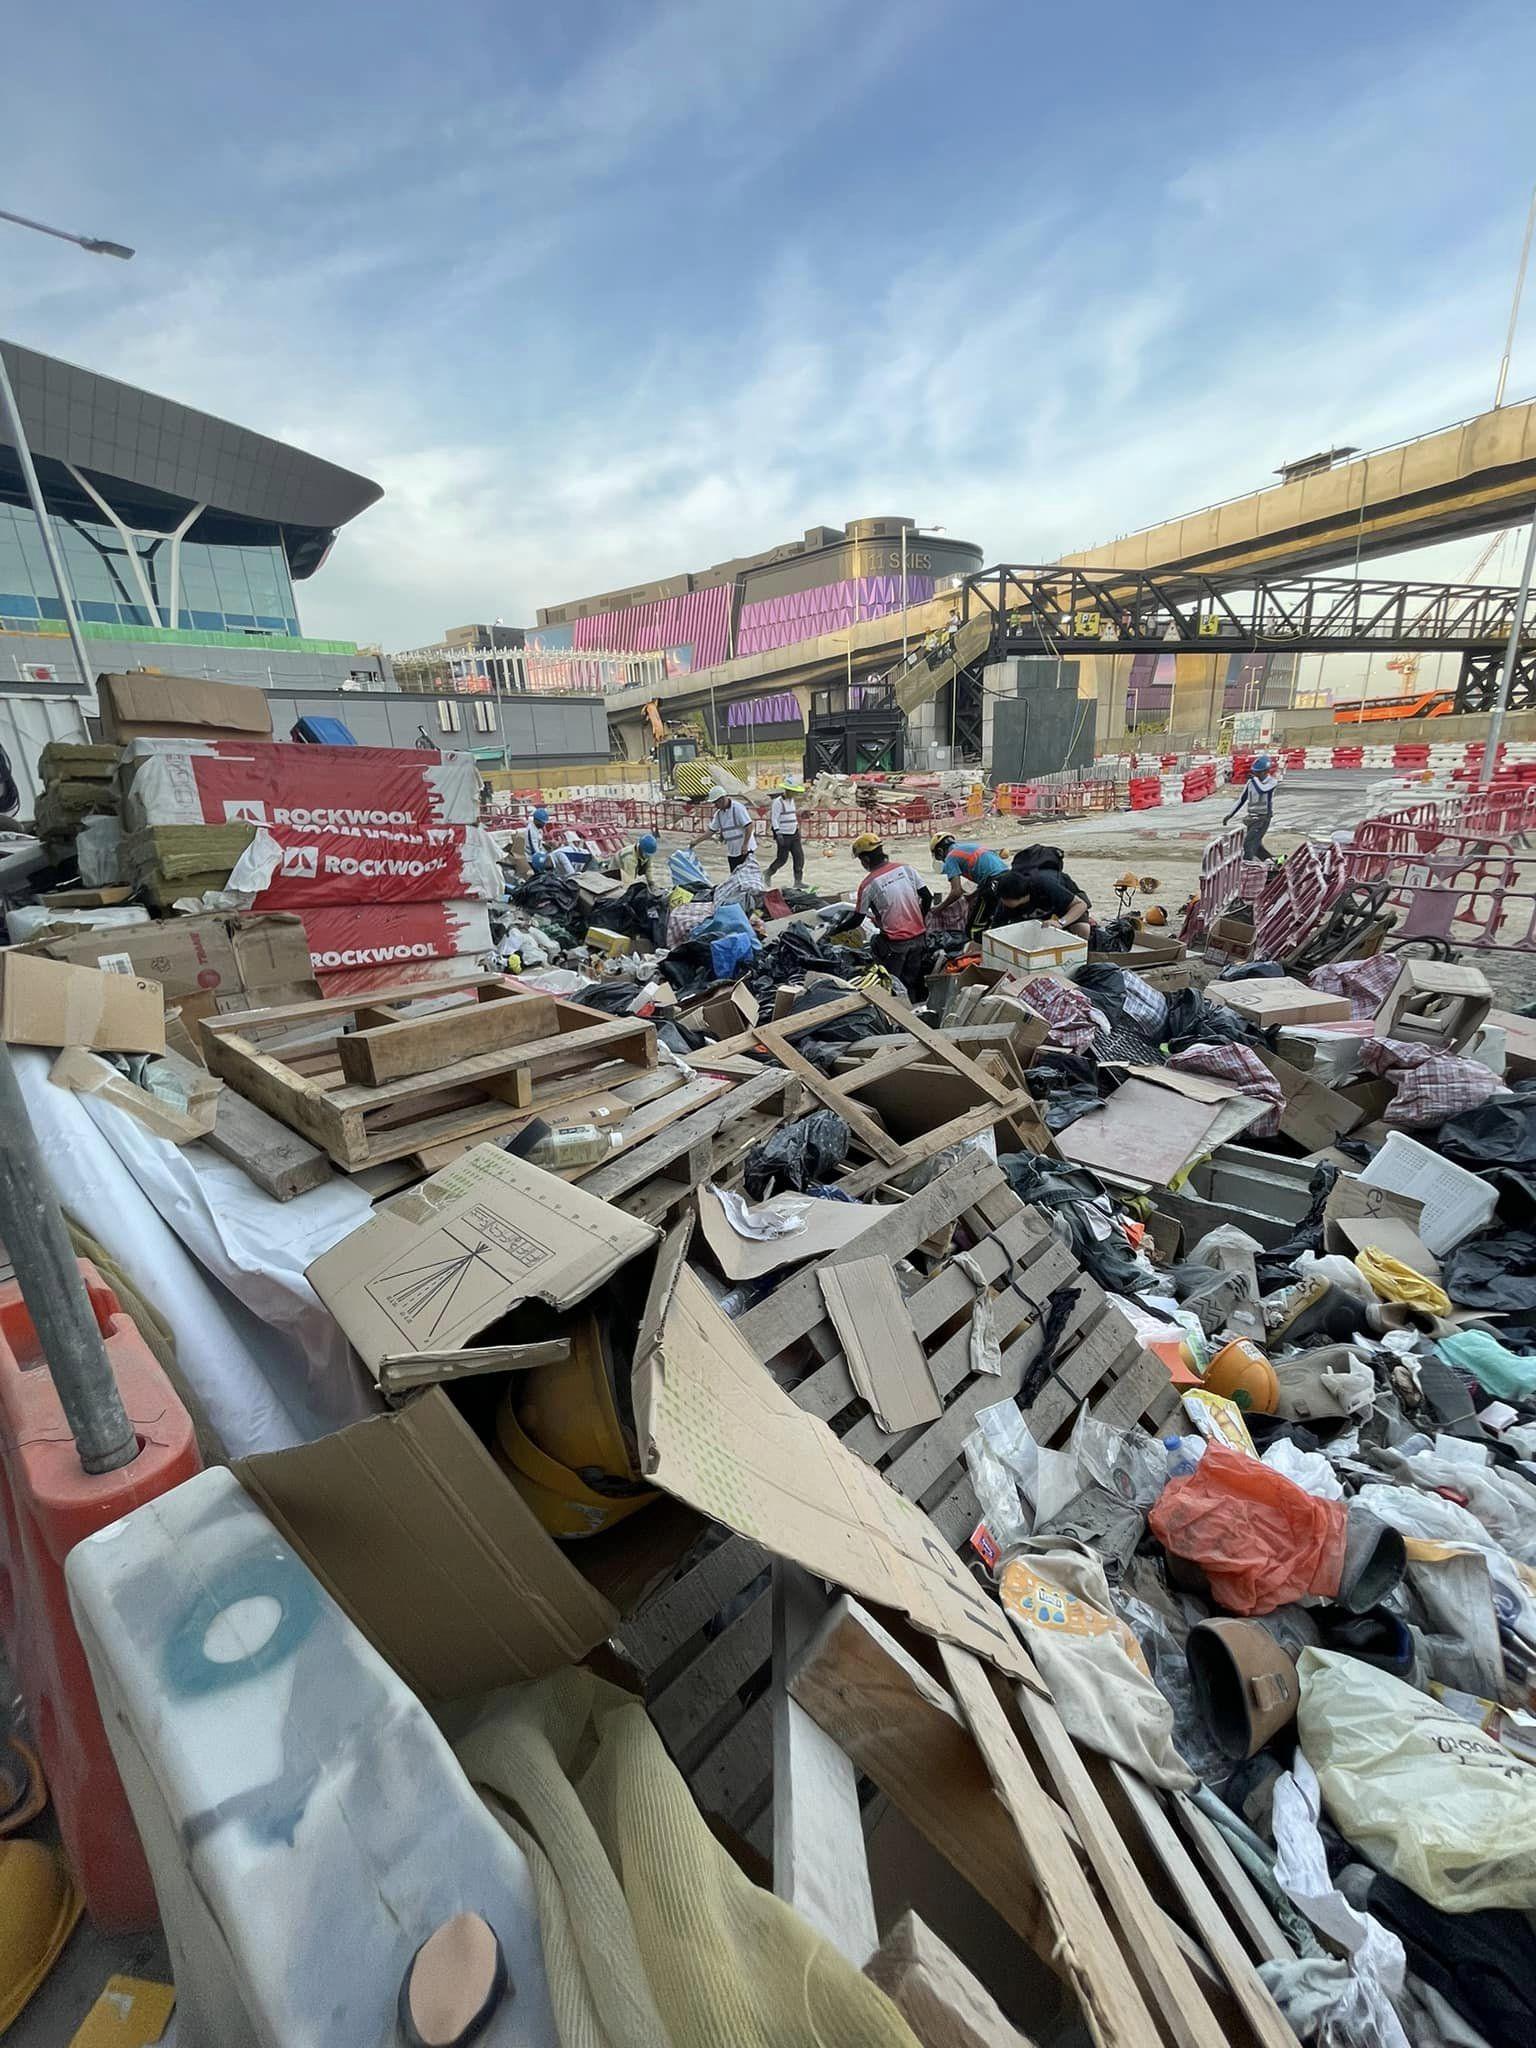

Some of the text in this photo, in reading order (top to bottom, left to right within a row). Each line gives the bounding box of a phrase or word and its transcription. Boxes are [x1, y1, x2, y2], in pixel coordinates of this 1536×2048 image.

[868, 552, 932, 570] 11 SKIES
[273, 808, 416, 825] ROCKWOOL
[325, 855, 447, 877] ROCKWOOL
[312, 942, 439, 968] ROCKWOOL
